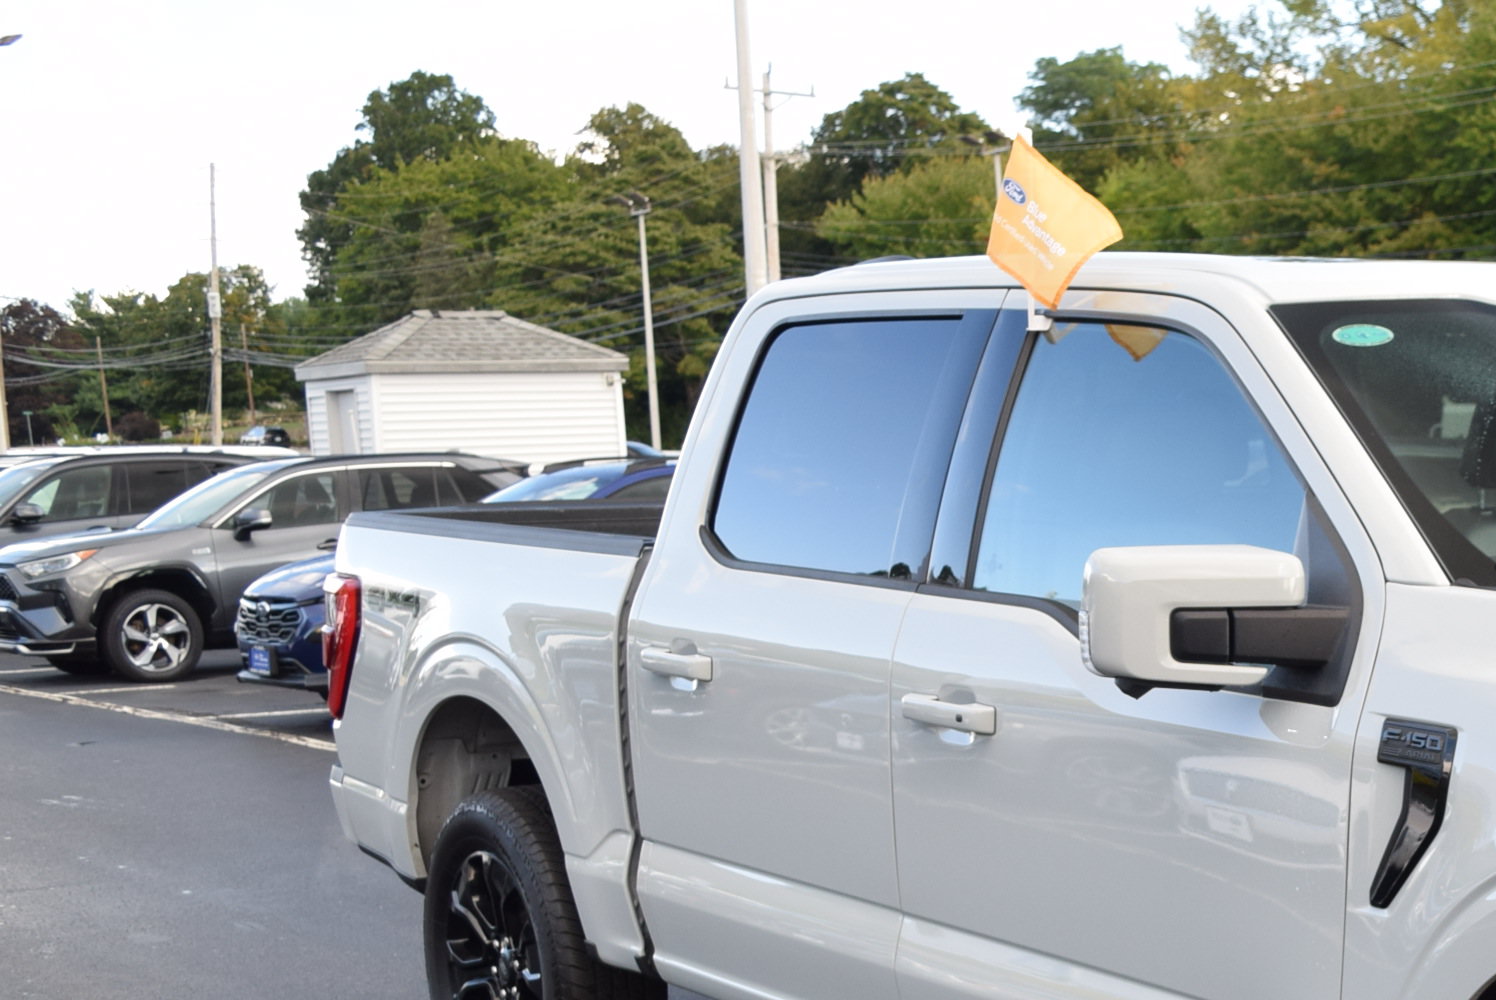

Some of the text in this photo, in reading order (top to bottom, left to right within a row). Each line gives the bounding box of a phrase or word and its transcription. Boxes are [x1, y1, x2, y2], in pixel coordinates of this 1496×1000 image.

[1004, 180, 1025, 204] Ford
[1027, 199, 1048, 221] Blue
[1022, 214, 1067, 257] Advantage
[1382, 727, 1444, 751] F-150
